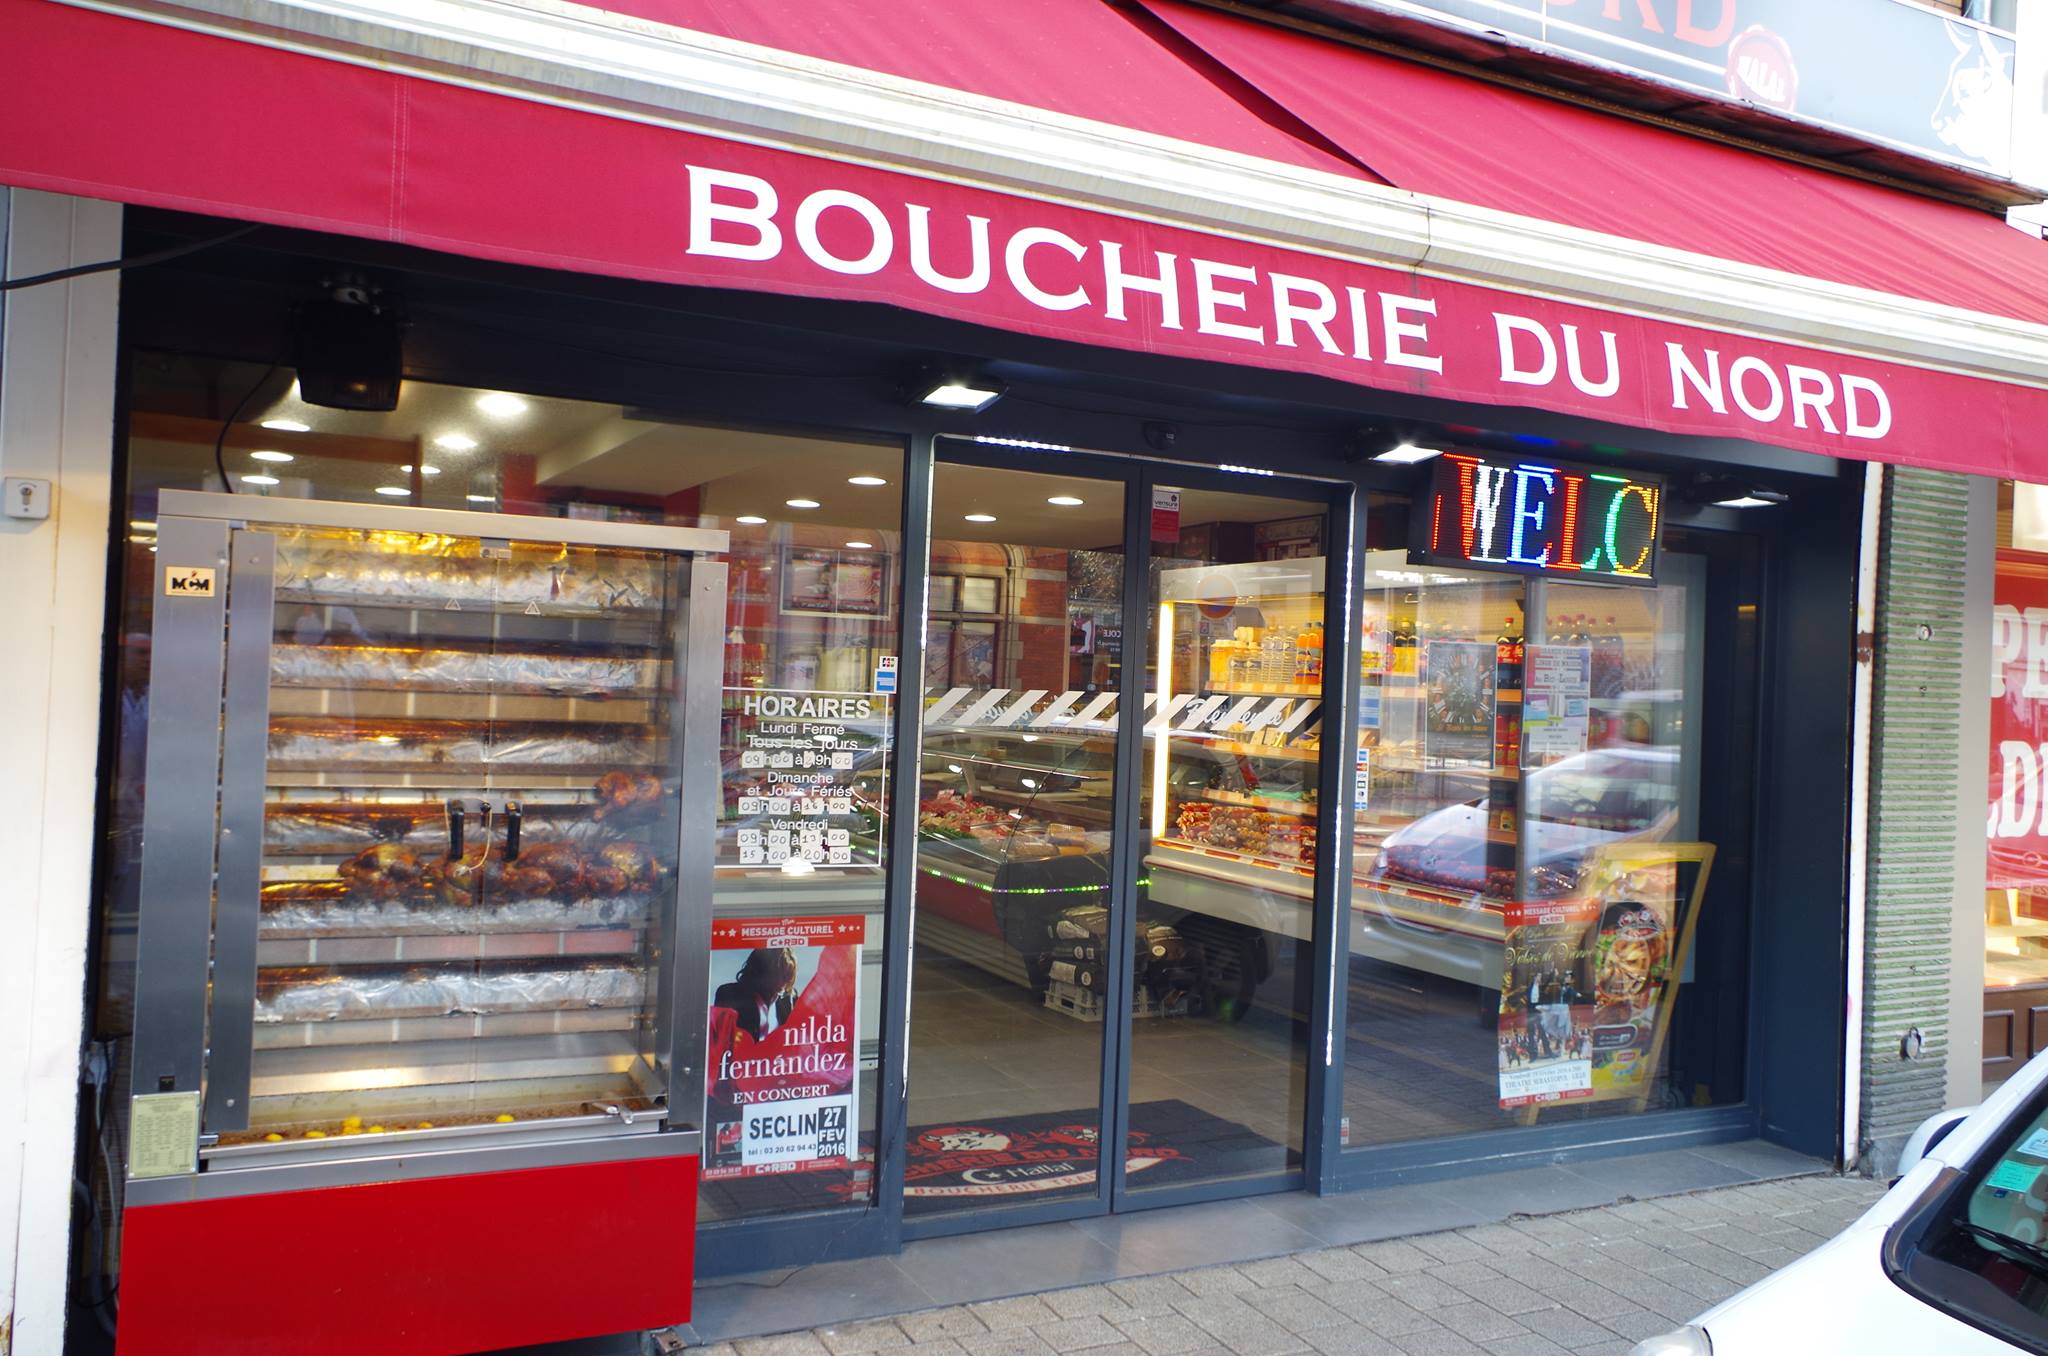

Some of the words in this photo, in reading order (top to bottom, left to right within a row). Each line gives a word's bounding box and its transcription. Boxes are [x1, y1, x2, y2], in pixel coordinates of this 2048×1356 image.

[685, 164, 1443, 376] BOUCHERIE
[1492, 311, 1620, 398] DU
[1664, 340, 1893, 439] NORD
[744, 695, 871, 719] HORAIRES
[760, 722, 797, 735] Lundi
[802, 723, 845, 736] Fermé
[746, 735, 784, 748] Tous
[790, 736, 813, 749] les
[768, 771, 834, 784] Dimanche
[747, 786, 760, 796] et
[768, 785, 805, 797] Jours
[812, 785, 852, 797] Fériés
[771, 819, 828, 830] Vendredi
[742, 926, 785, 937] MESSAGE
[787, 924, 834, 935] CULTUREL
[784, 1015, 846, 1047] nilda
[718, 1044, 846, 1081] fernández
[734, 1091, 754, 1104] EN
[758, 1084, 830, 1102] CONCERT
[823, 1108, 842, 1128] 27
[749, 1113, 817, 1140] SECLIN
[819, 1128, 845, 1142] FEV
[819, 1143, 845, 1156] 2016
[913, 1182, 1040, 1196] BOUCHERIE
